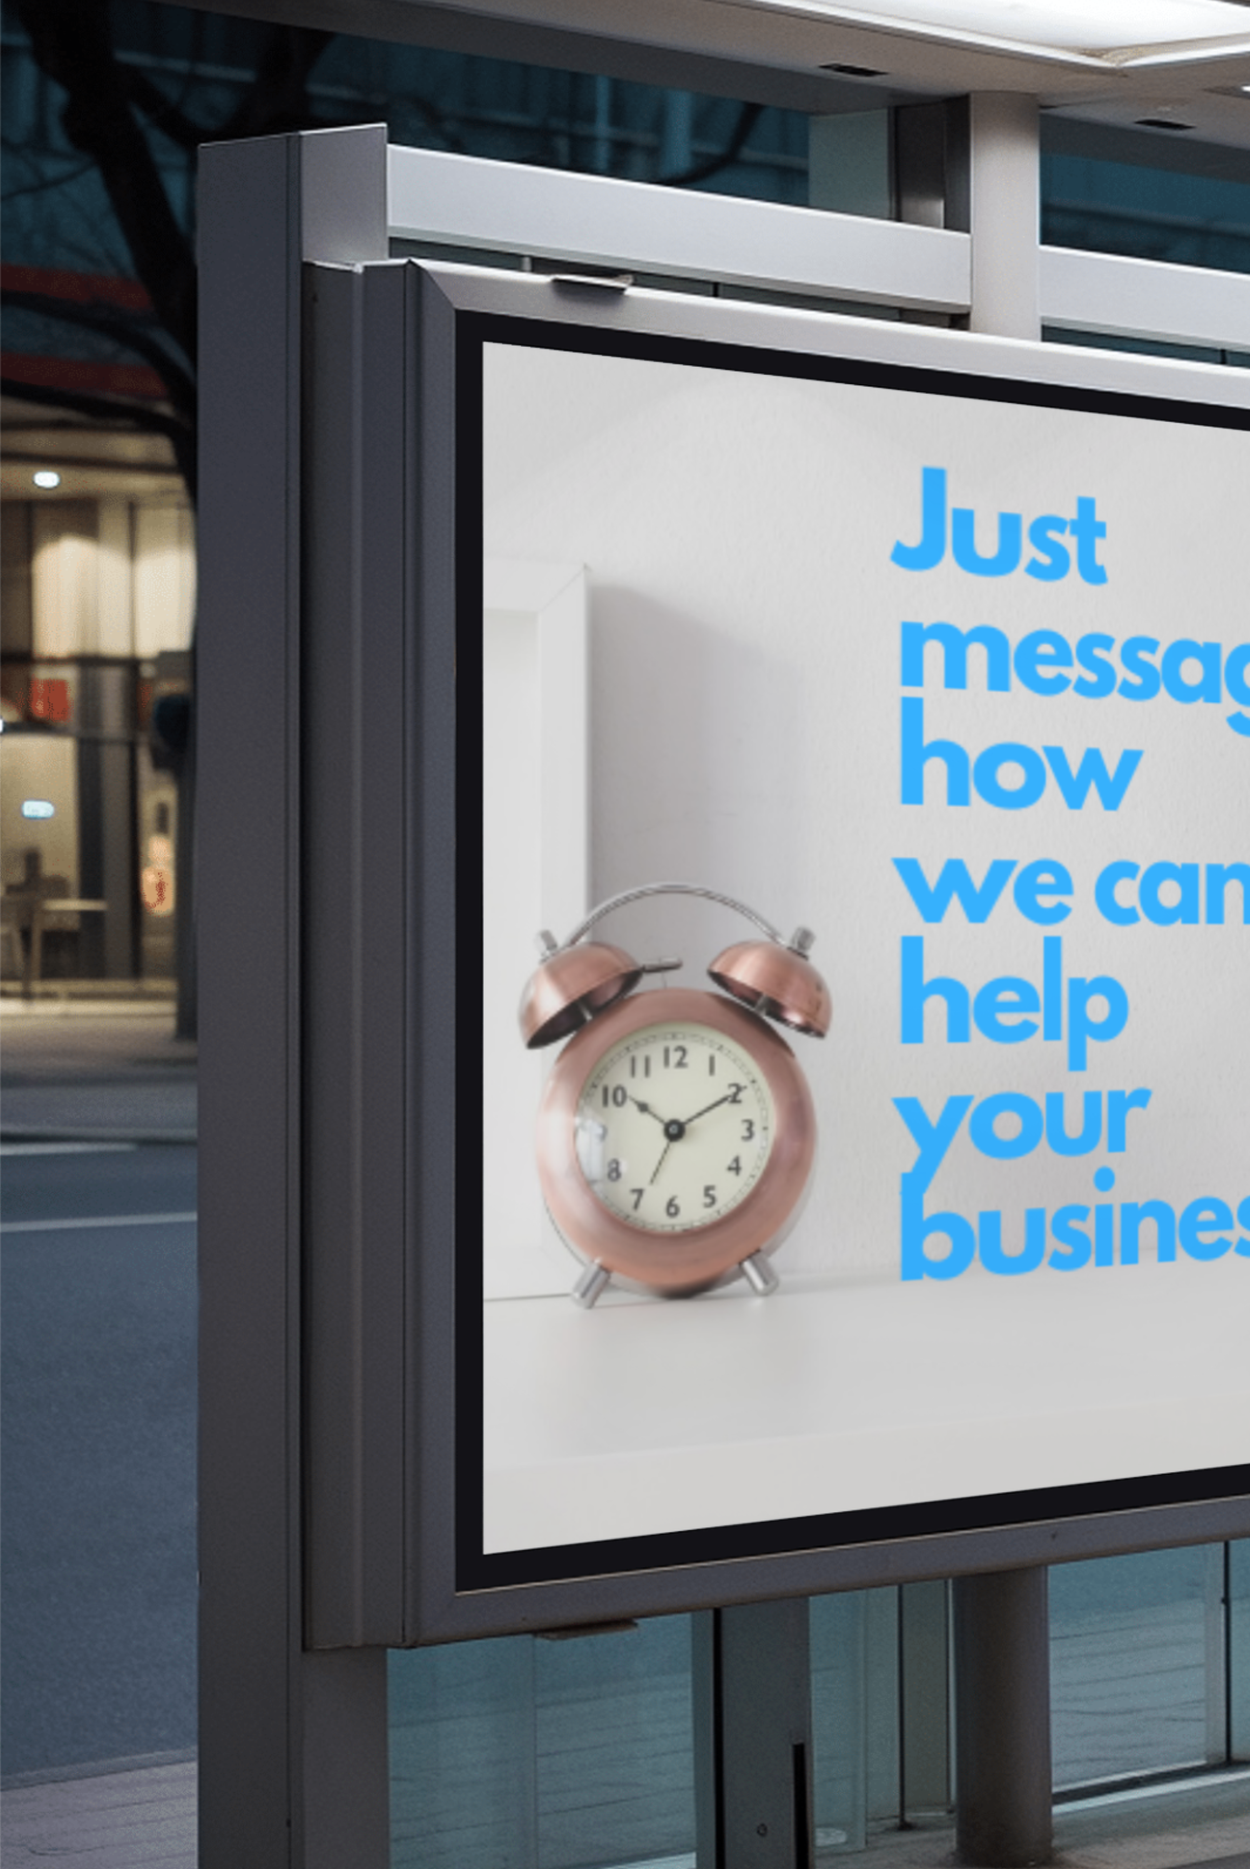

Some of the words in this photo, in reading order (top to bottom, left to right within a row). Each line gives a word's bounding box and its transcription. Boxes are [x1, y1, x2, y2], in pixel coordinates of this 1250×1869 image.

[890, 466, 1108, 586] Just
[901, 696, 1145, 811] how
[892, 858, 1075, 926] we
[901, 936, 1129, 1072] help
[630, 1055, 651, 1078] 11
[663, 1046, 688, 1068] 12
[602, 1085, 627, 1108] 10
[728, 1083, 744, 1104] 2
[741, 1120, 755, 1141] 3
[892, 1087, 1152, 1195] your
[607, 1159, 622, 1183] 8
[727, 1156, 742, 1176] 4
[630, 1189, 645, 1212] 7
[666, 1197, 680, 1219] 6
[703, 1186, 717, 1208] 5
